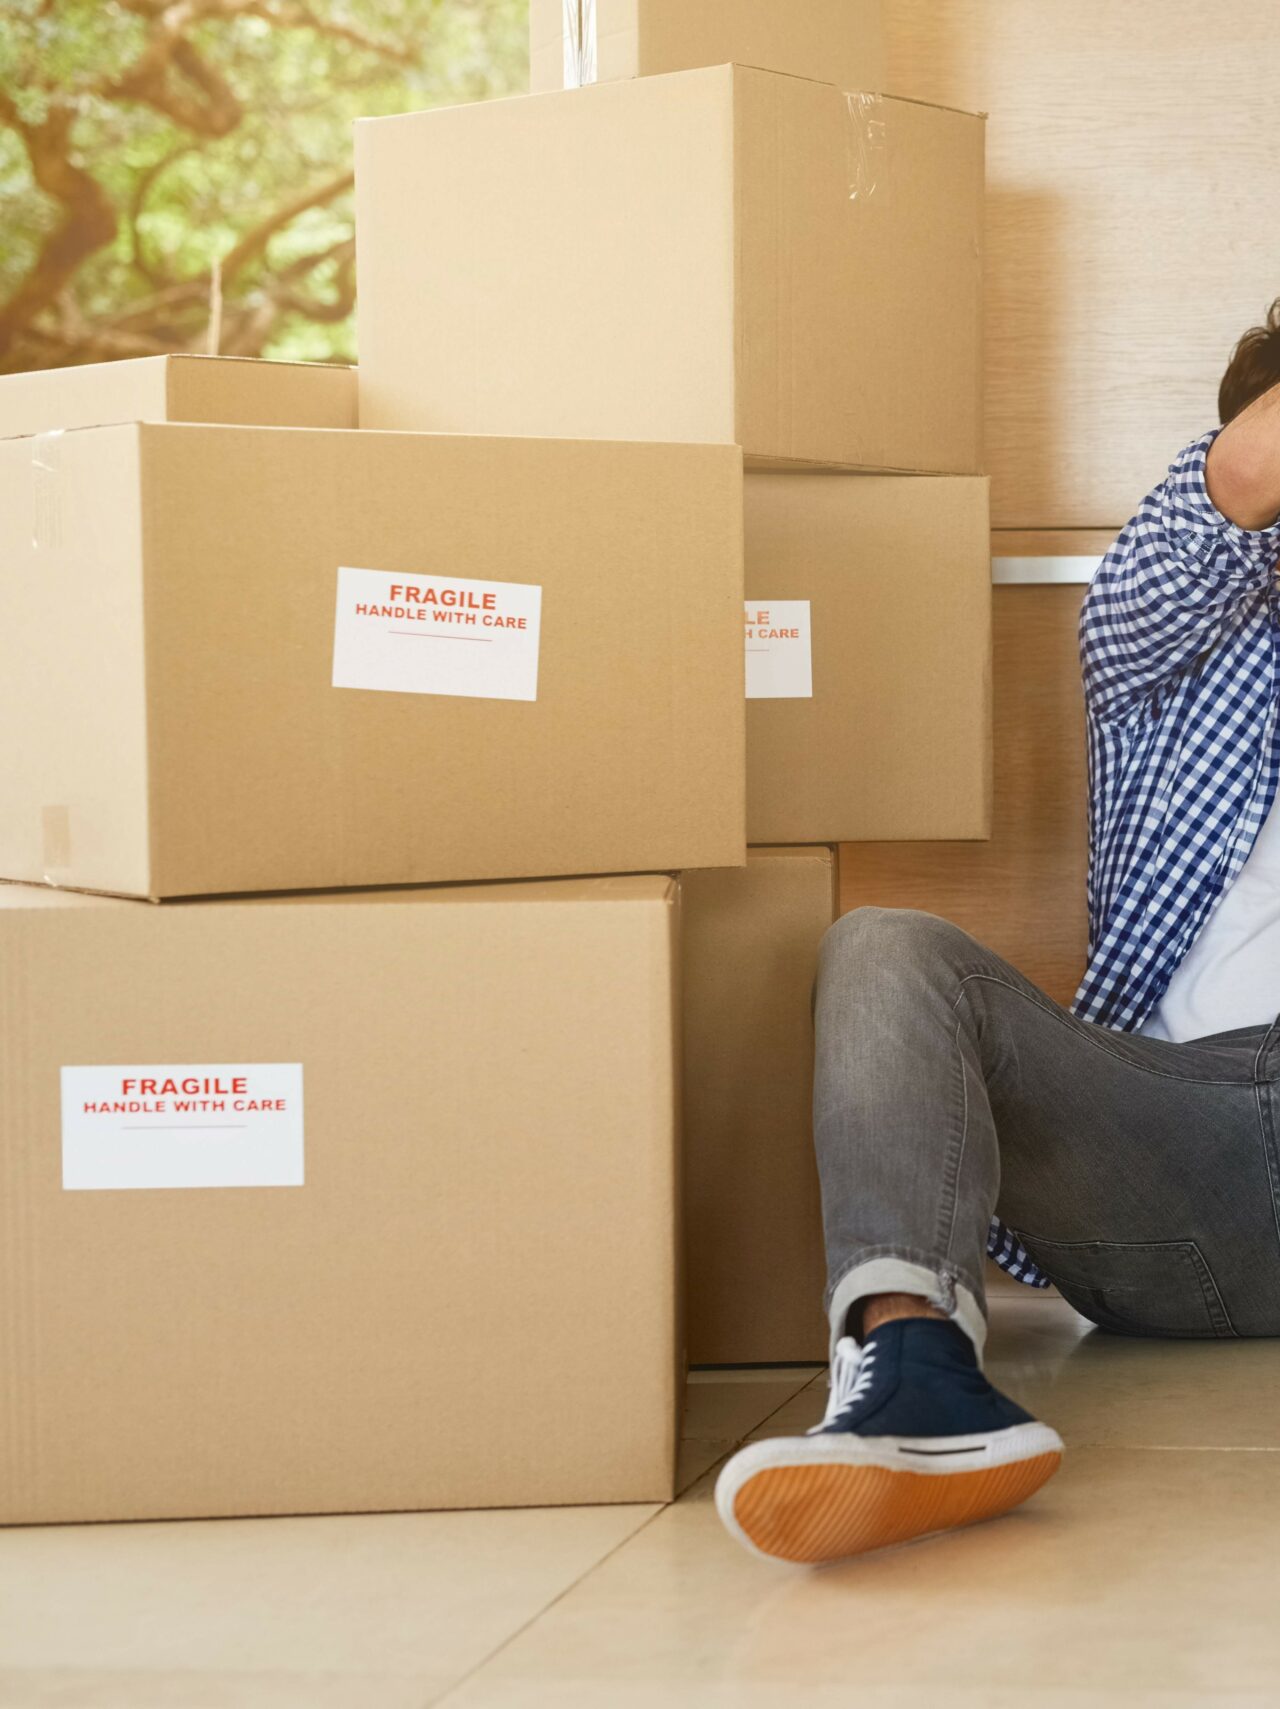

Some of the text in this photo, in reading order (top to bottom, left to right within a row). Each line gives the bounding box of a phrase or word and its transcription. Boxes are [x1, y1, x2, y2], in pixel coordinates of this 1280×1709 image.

[389, 584, 497, 611] FRAGILE
[355, 603, 527, 630] HANDLE WITH CARE
[758, 628, 799, 639] CARE
[121, 1077, 248, 1096] FRAGILE
[83, 1099, 287, 1114] HANDLE WITH CARE
